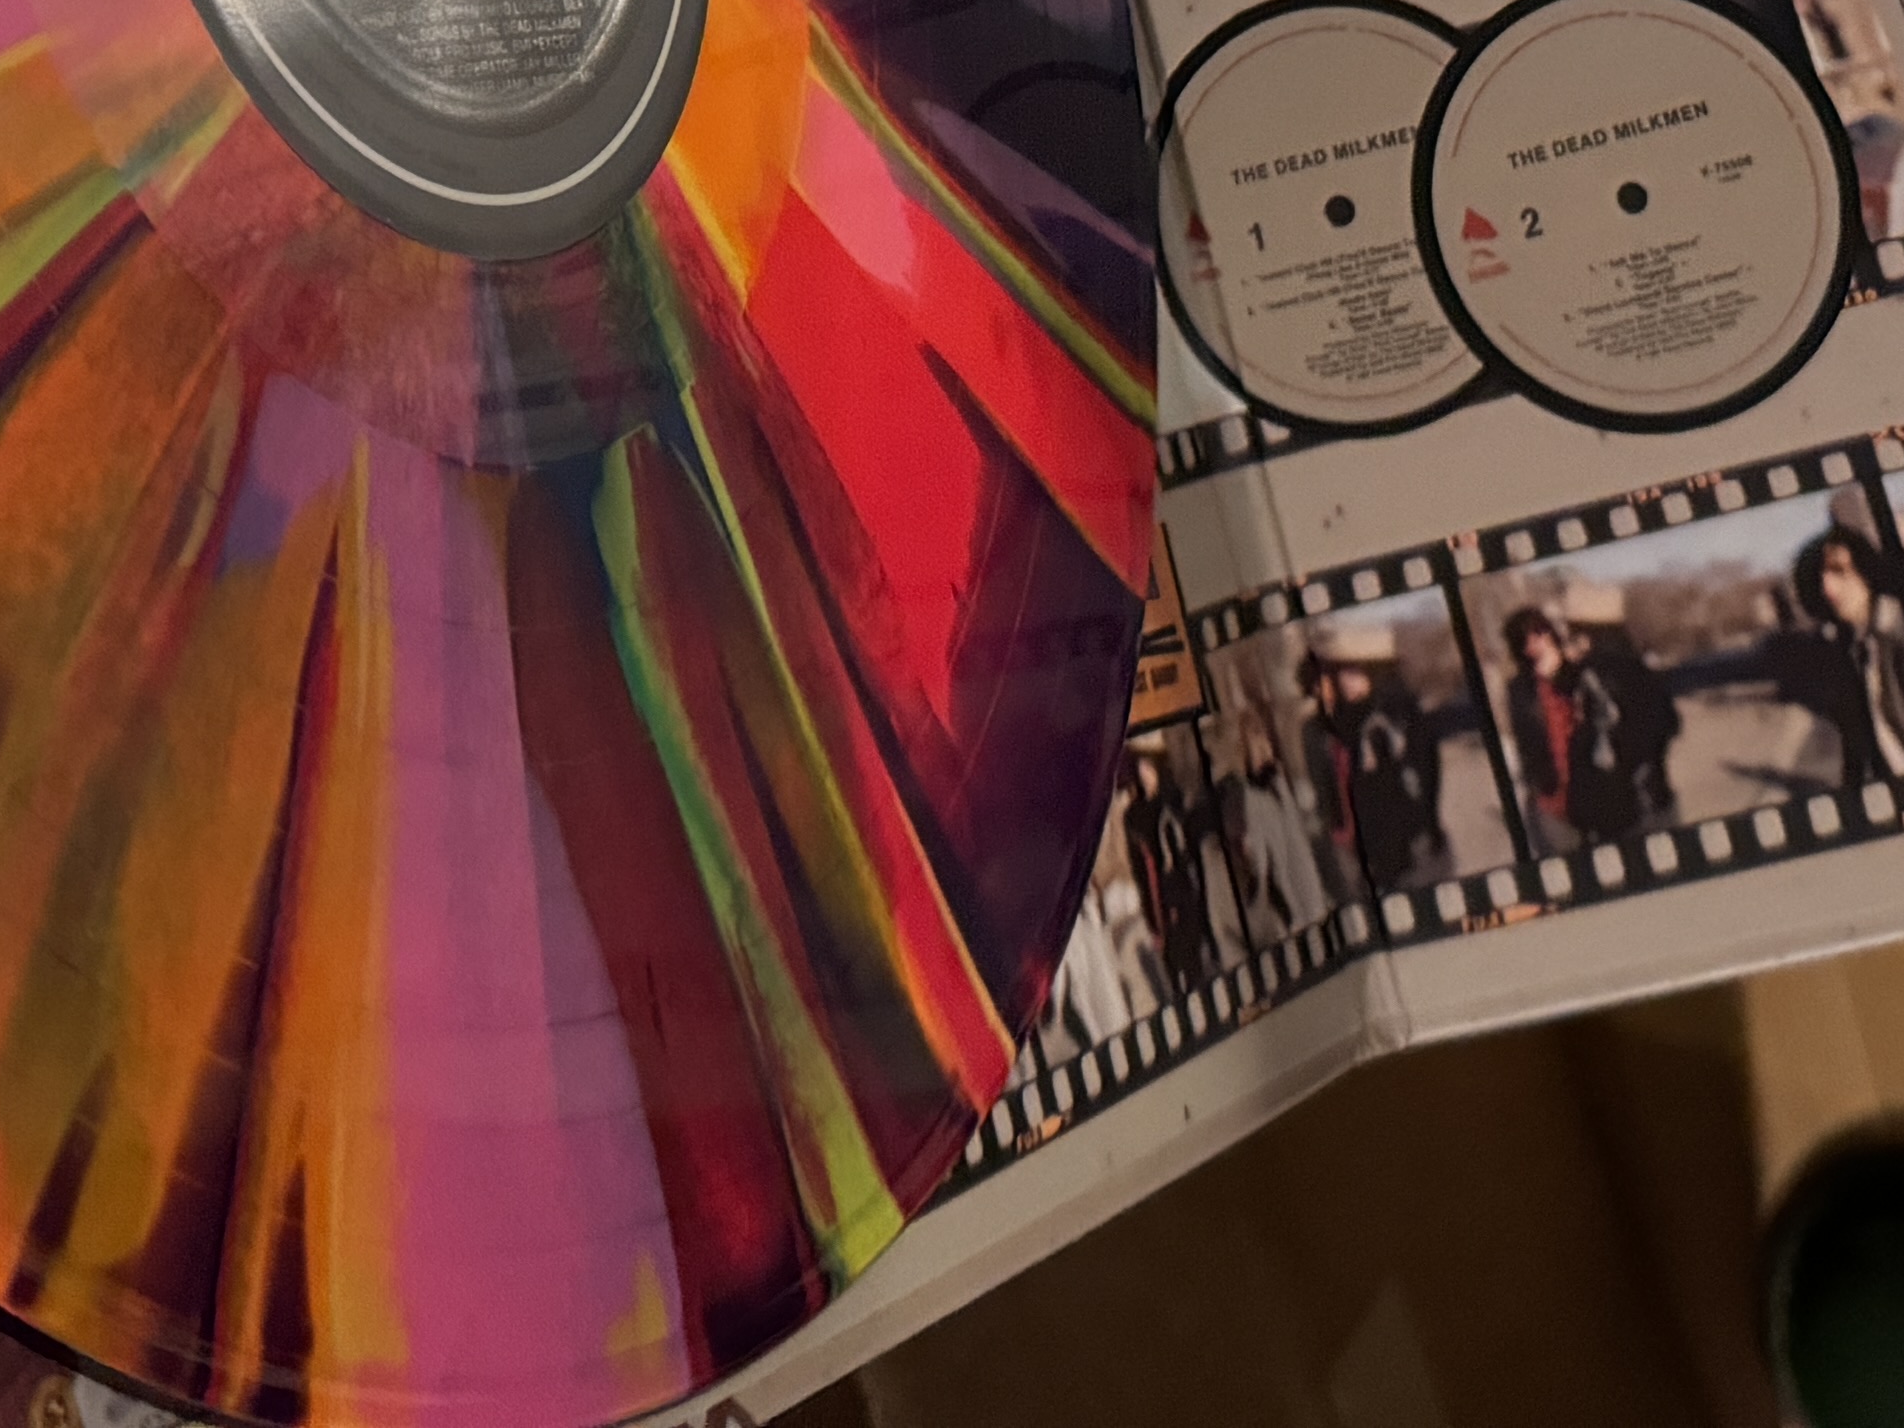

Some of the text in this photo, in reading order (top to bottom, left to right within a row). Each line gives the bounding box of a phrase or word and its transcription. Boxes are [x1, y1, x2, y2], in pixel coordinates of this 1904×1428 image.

[1508, 101, 1710, 171] THE DEAD MILKMEN
[1231, 164, 1269, 186] THE
[1274, 149, 1327, 176] DEAD
[1246, 221, 1265, 252] 1
[1520, 206, 1544, 239] 2
